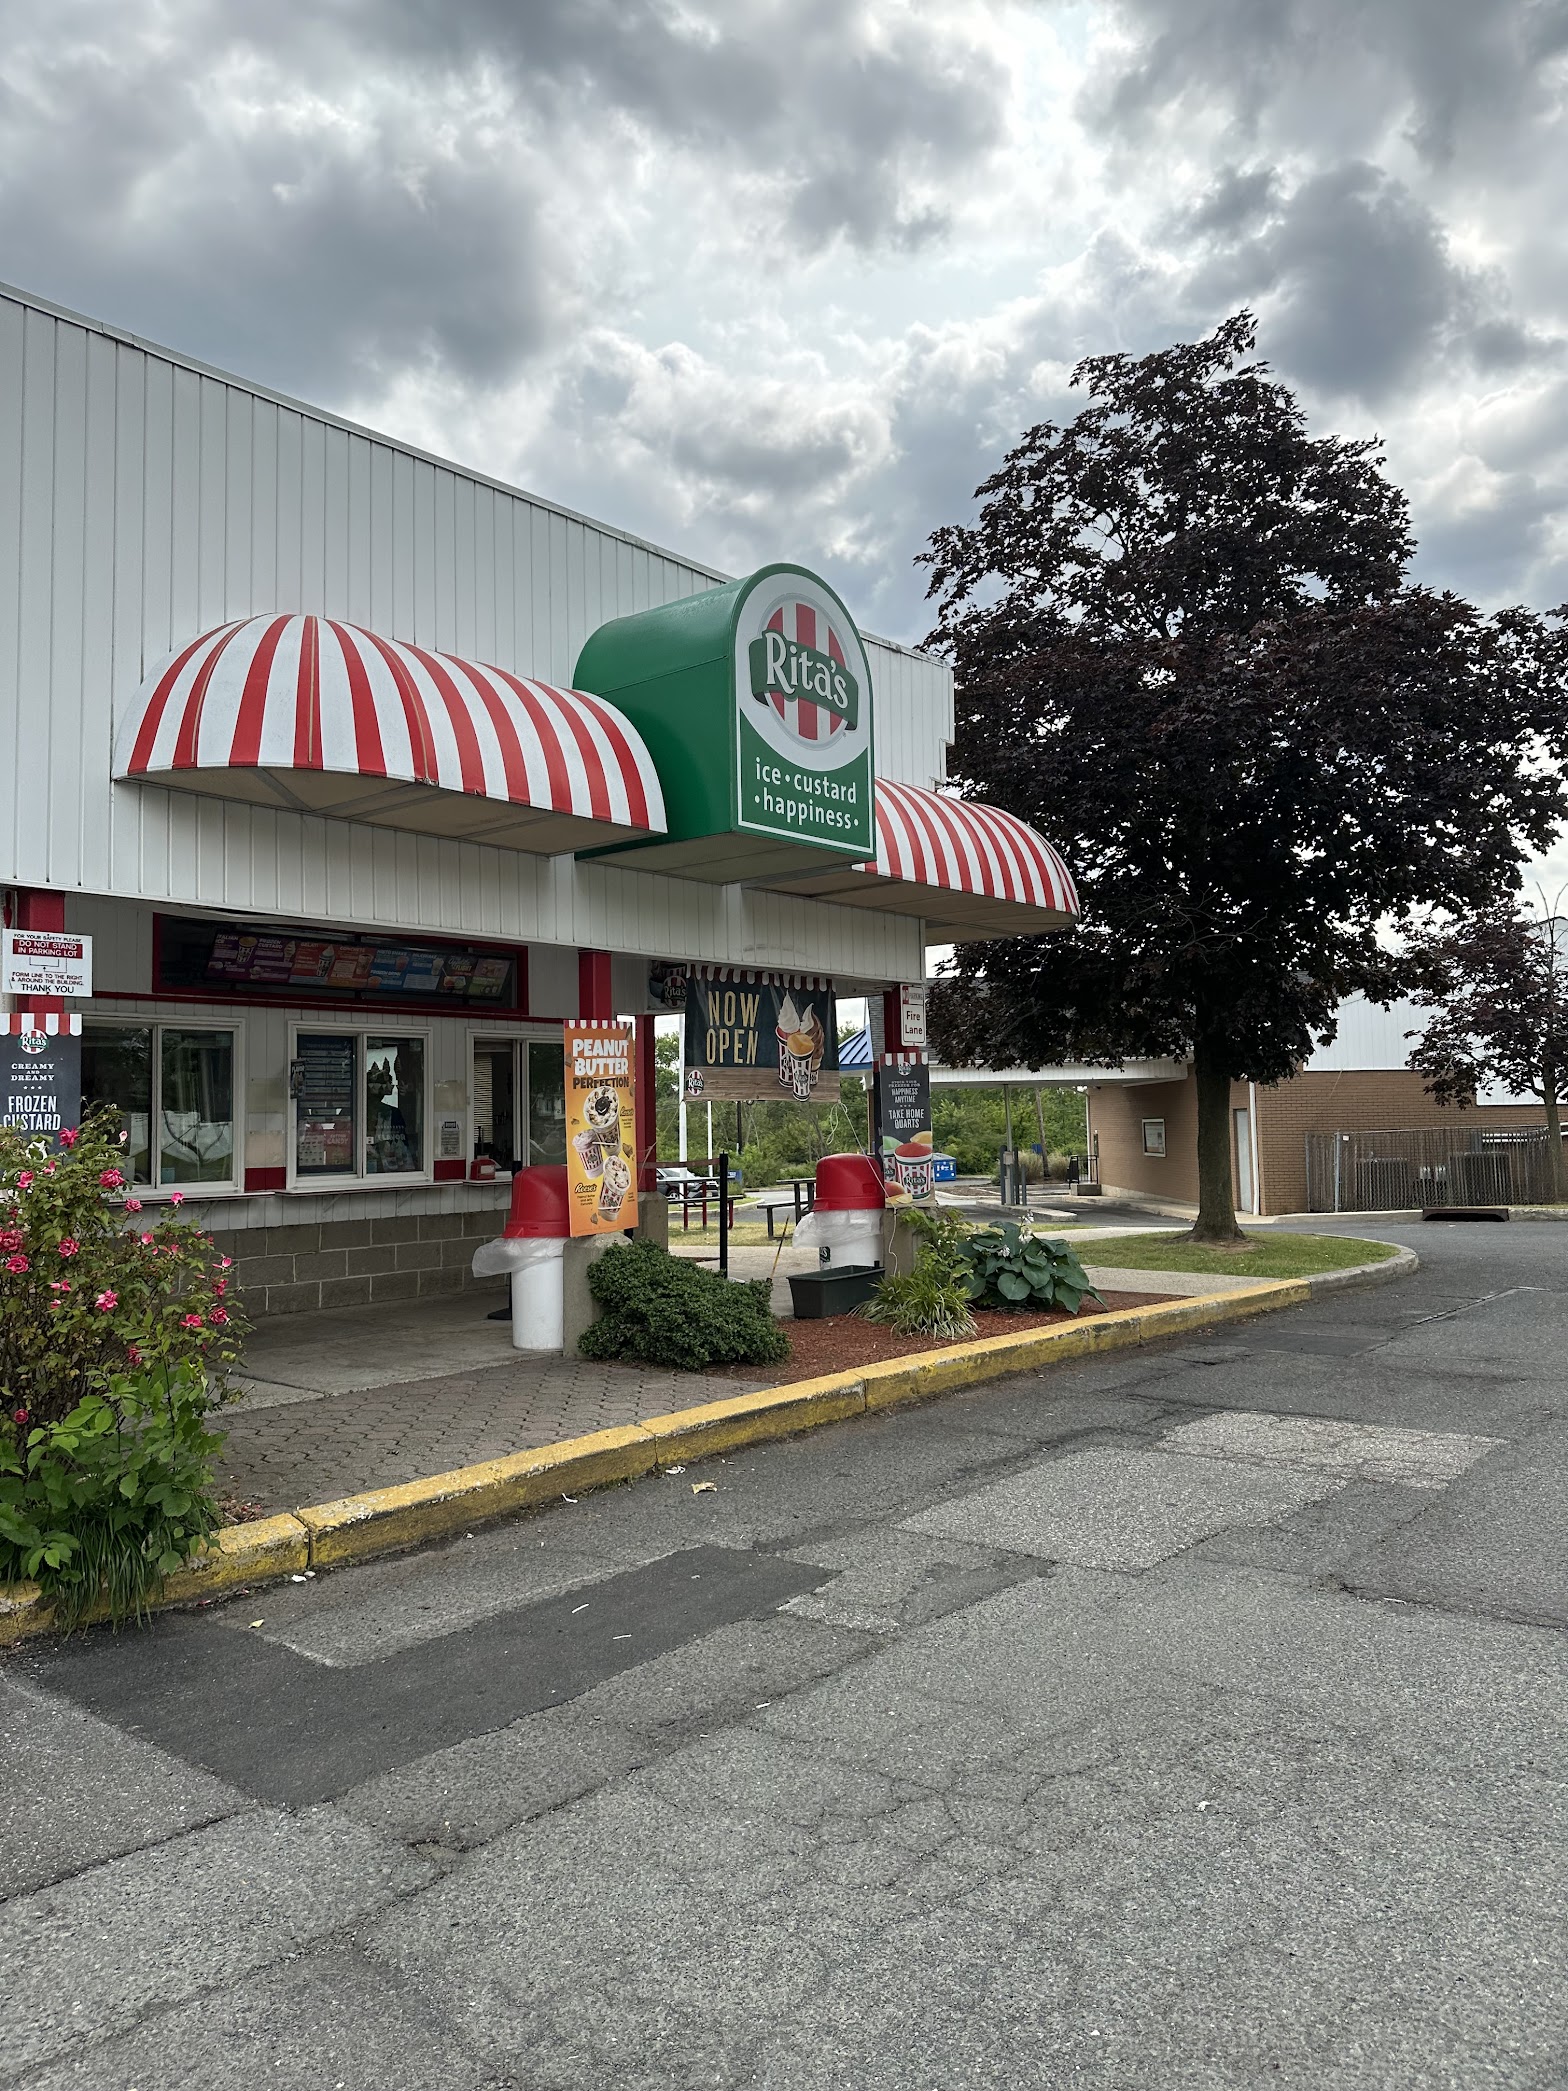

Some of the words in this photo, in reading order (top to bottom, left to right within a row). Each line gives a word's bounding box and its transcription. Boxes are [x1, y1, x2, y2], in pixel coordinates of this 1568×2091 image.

[765, 632, 848, 709] Rita's
[755, 757, 781, 785] ice
[794, 772, 857, 804] custard
[28, 947, 62, 956] PARKING
[52, 942, 77, 950] STAND
[21, 984, 51, 992] THANK
[55, 985, 74, 994] YOU
[664, 986, 686, 998] Rita's
[708, 991, 760, 1028] NOW
[906, 1010, 920, 1021] Fire
[905, 1024, 923, 1034] Lane
[22, 1037, 46, 1047] Rita's
[572, 1038, 629, 1057] PEANUT
[706, 1028, 759, 1065] OPEN
[574, 1057, 629, 1076] BUTTER
[572, 1076, 630, 1089] PERFECTION
[688, 1078, 704, 1089] Rita's
[891, 1088, 918, 1096] HAPPINESS
[8, 1095, 57, 1113] FROZEN
[894, 1095, 916, 1104] ANYTIME
[888, 1109, 904, 1120] TAKE
[906, 1108, 924, 1119] HOME
[894, 1118, 920, 1129] QUARTS
[906, 1175, 926, 1184] Rita's
